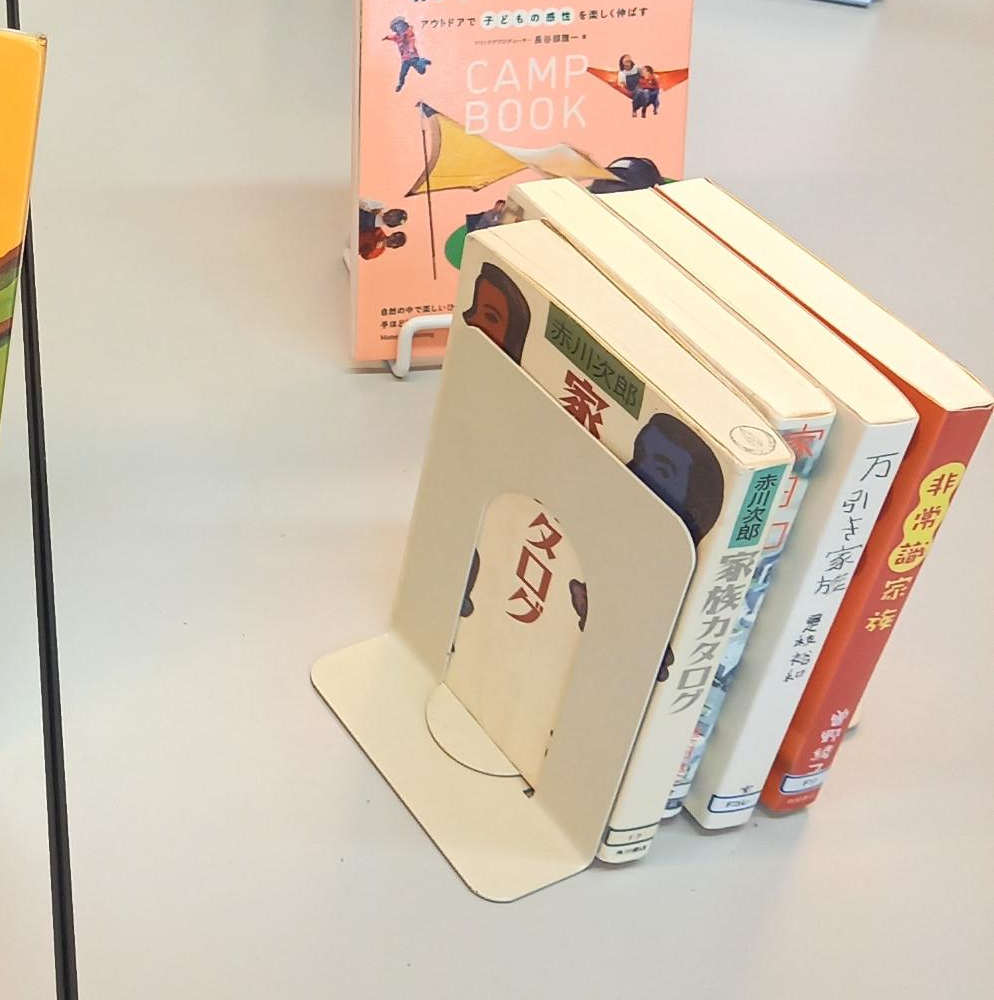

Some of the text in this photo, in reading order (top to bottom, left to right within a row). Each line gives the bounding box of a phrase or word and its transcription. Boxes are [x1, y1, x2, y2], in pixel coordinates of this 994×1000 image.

[464, 95, 588, 137] BOOK
[465, 54, 589, 95] CAMP
[551, 320, 639, 407] 赤川次郎
[735, 473, 778, 542] 赤川次郎
[814, 452, 899, 595] 万引き家族
[865, 471, 959, 633] 非常識家族
[505, 511, 562, 623] タログ
[669, 550, 760, 715] 家族カタログ
